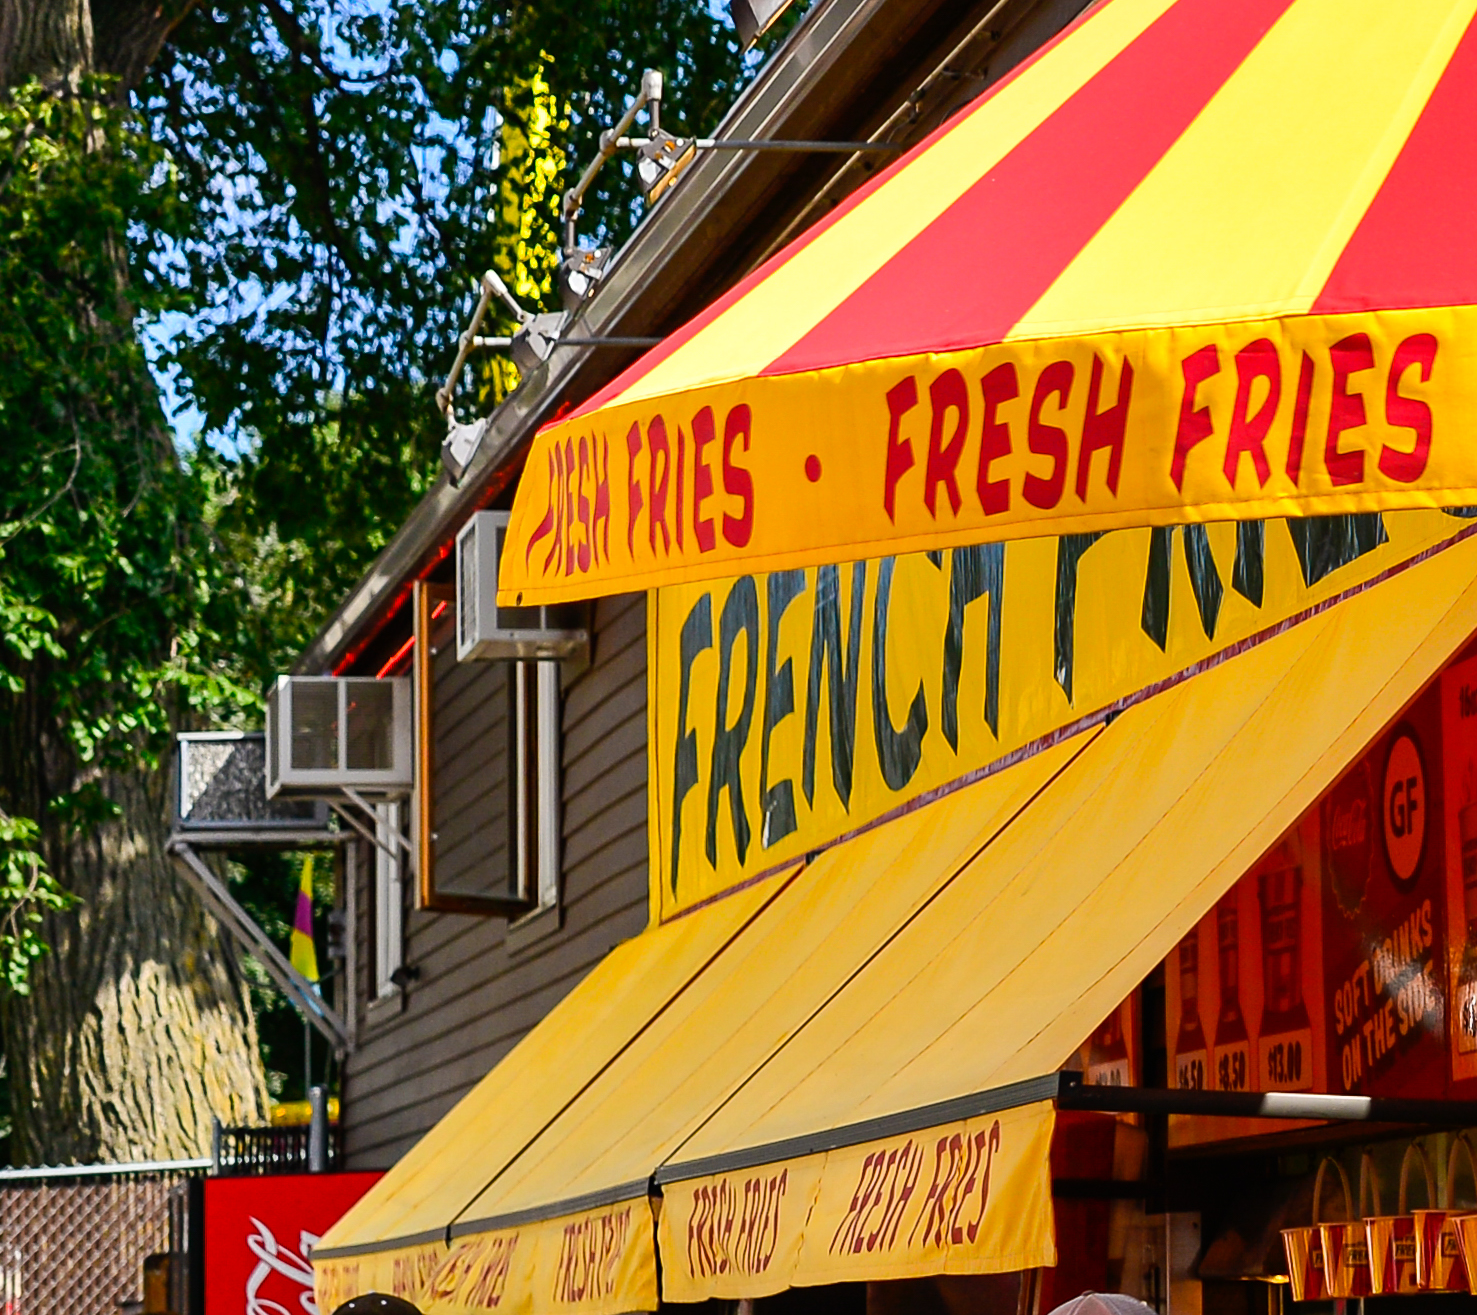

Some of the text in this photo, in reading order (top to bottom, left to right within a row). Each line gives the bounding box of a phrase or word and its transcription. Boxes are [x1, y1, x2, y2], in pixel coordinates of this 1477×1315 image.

[525, 429, 611, 579] FRESH
[626, 403, 755, 564] FRIES
[883, 350, 1135, 524] FRESH
[1170, 332, 1438, 492] FRIES
[671, 542, 1005, 901] FRENCH
[1389, 776, 1418, 838] GF
[1335, 958, 1370, 1036] SOFT
[1342, 1033, 1362, 1092] ON
[1364, 996, 1397, 1067] THE
[1268, 1040, 1302, 1083] $13.00
[735, 1167, 788, 1277] FRIES
[828, 1138, 925, 1256] FRESH
[907, 1119, 1001, 1250] FRIES
